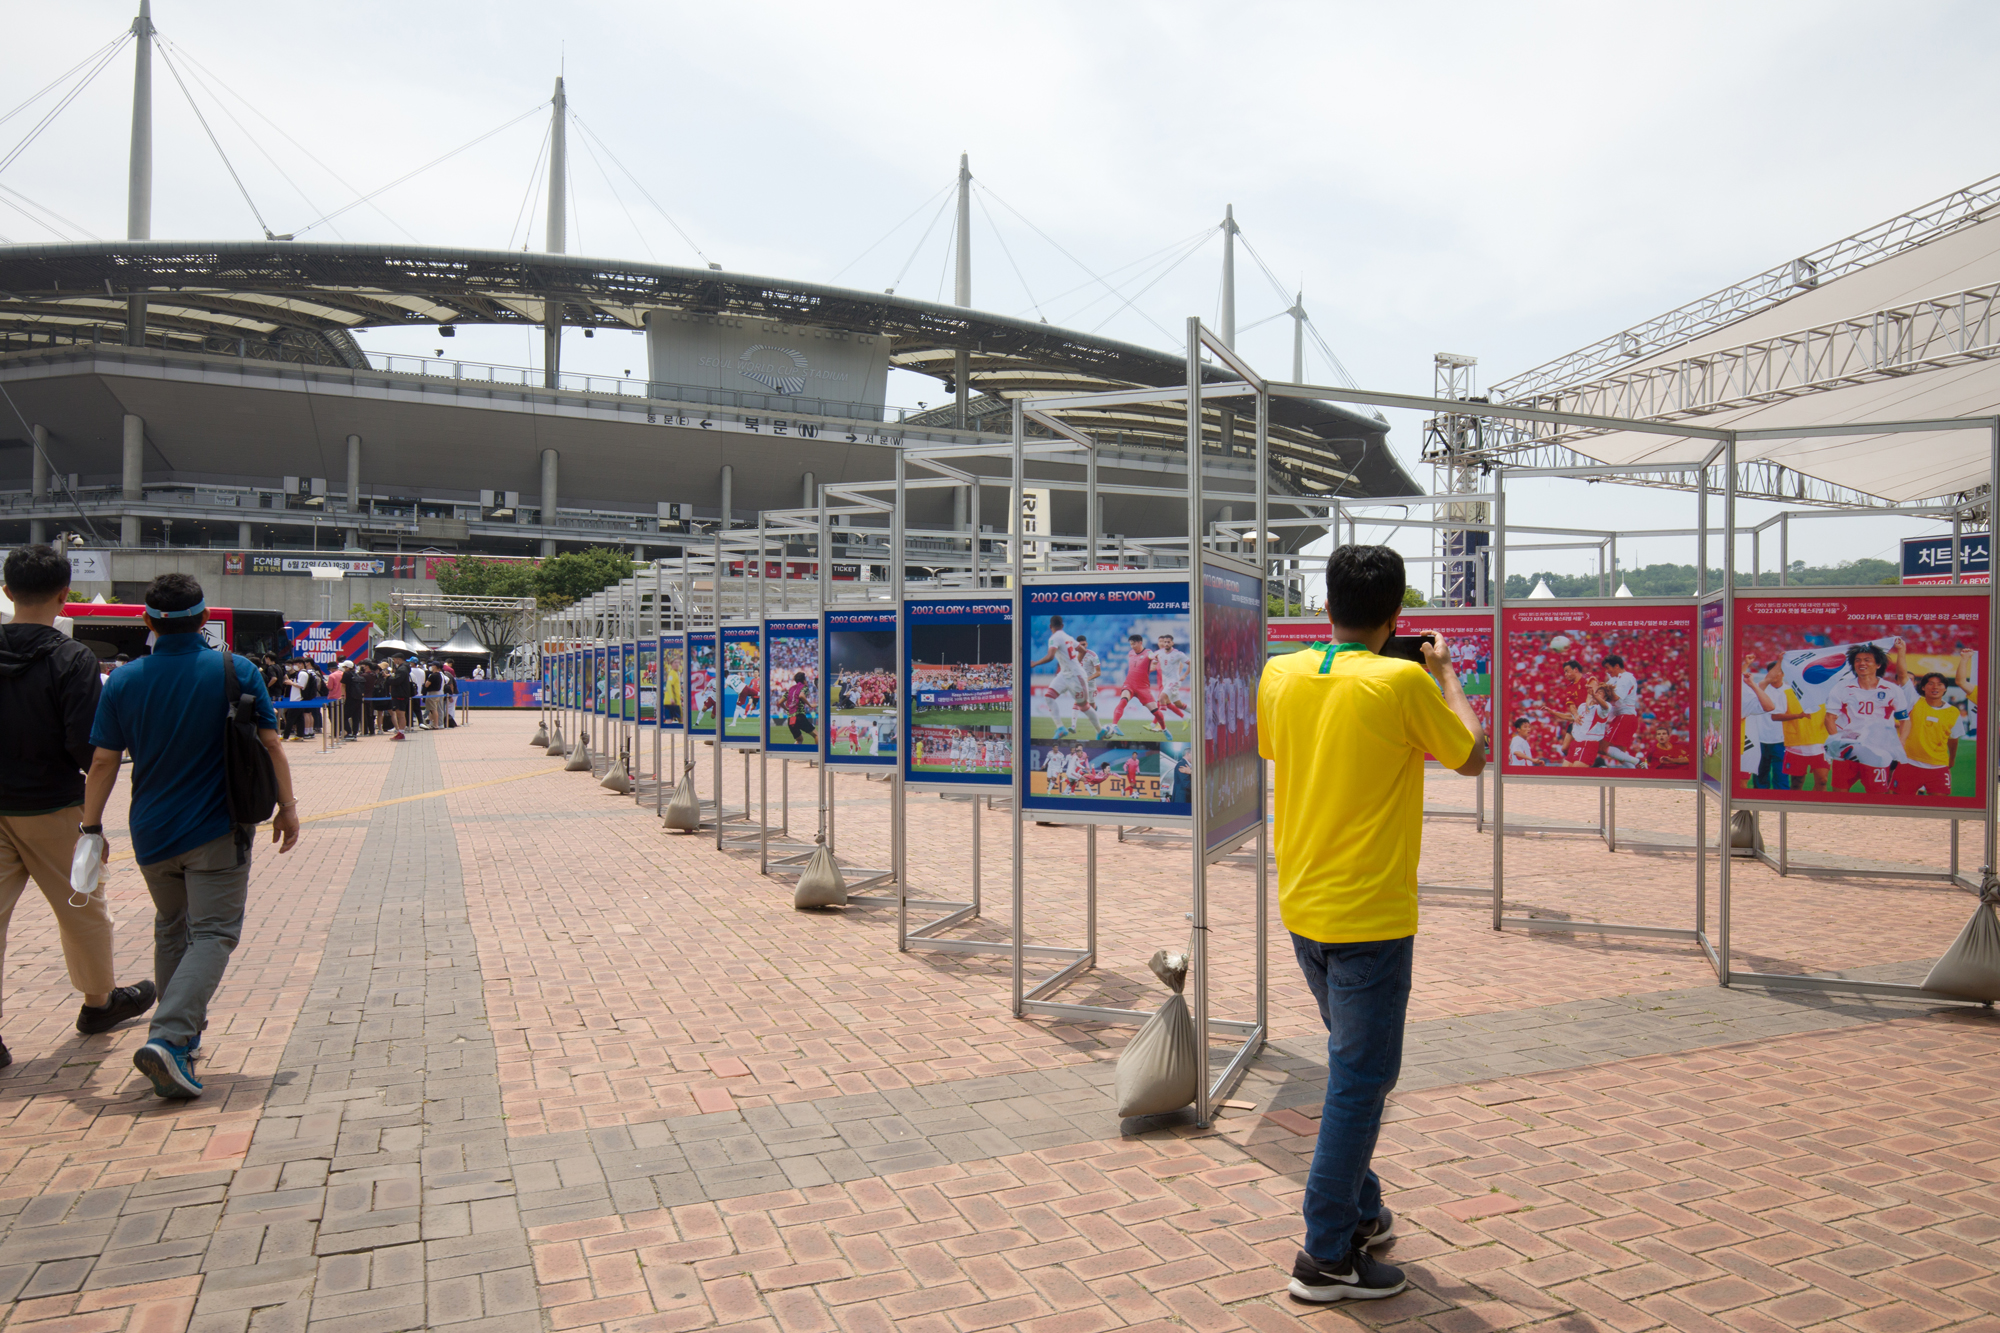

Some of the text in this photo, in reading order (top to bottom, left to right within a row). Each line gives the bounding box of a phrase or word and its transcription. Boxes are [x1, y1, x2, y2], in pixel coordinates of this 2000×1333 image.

[698, 356, 849, 381] SEOUL WORLD CUP STADIUM
[253, 557, 281, 566] FC서울
[1031, 592, 1058, 602] 2002
[1061, 591, 1098, 602] GLORY
[1108, 590, 1155, 601] BEYOND
[912, 606, 933, 614] 2002
[935, 605, 964, 614] GLORY
[972, 605, 1010, 614] BEYOND
[309, 628, 331, 639] NIKE
[296, 640, 344, 651] FOOTBALL
[302, 652, 337, 663] STUDIO
[1858, 701, 1874, 715] 20
[1873, 768, 1887, 782] 20
